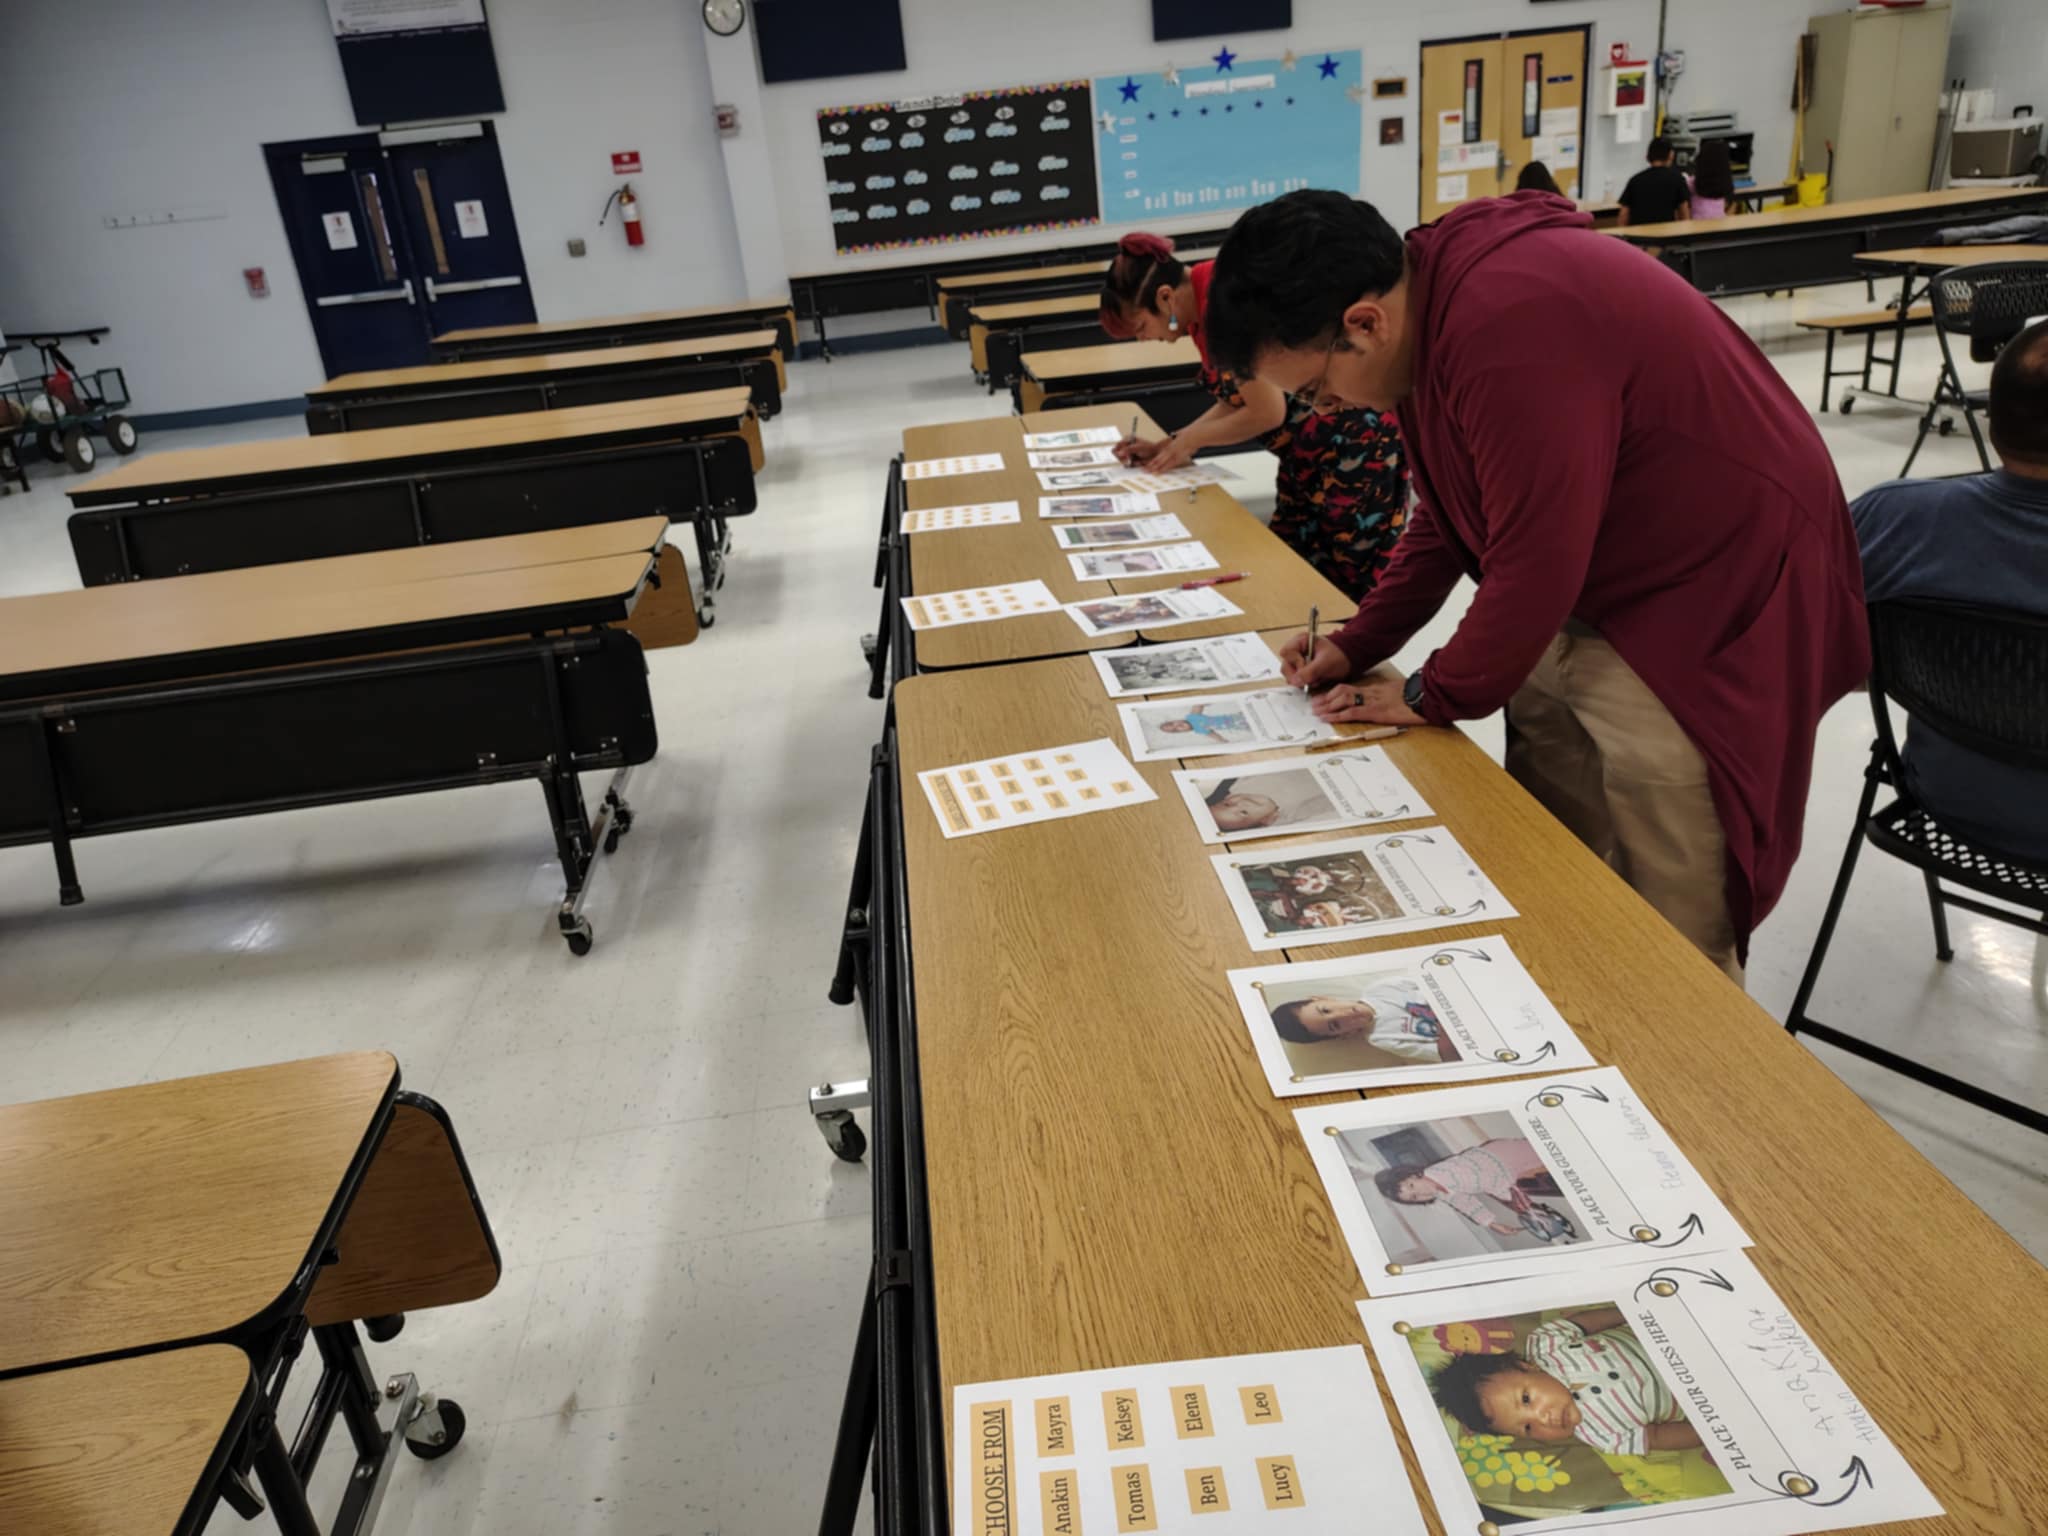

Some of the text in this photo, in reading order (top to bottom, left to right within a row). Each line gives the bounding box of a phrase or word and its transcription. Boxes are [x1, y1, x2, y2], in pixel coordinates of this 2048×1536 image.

[1543, 1140, 1571, 1172] GUESS
[1562, 1168, 1589, 1196] YOUR
[1579, 1194, 1609, 1226] PLACE
[1659, 1345, 1695, 1385] GUESS
[1115, 1396, 1134, 1443] Kelsey
[1184, 1391, 1204, 1432] Elena
[1253, 1391, 1272, 1418] Leo
[1687, 1385, 1720, 1424] YOUR
[982, 1409, 1003, 1460] FROM
[1047, 1403, 1068, 1450] Mayra
[1711, 1423, 1752, 1471] PLACE
[1126, 1471, 1146, 1526] Tomas
[1200, 1474, 1219, 1506] Ben
[1271, 1463, 1294, 1502] Lucy
[1051, 1477, 1072, 1535] Anakin
